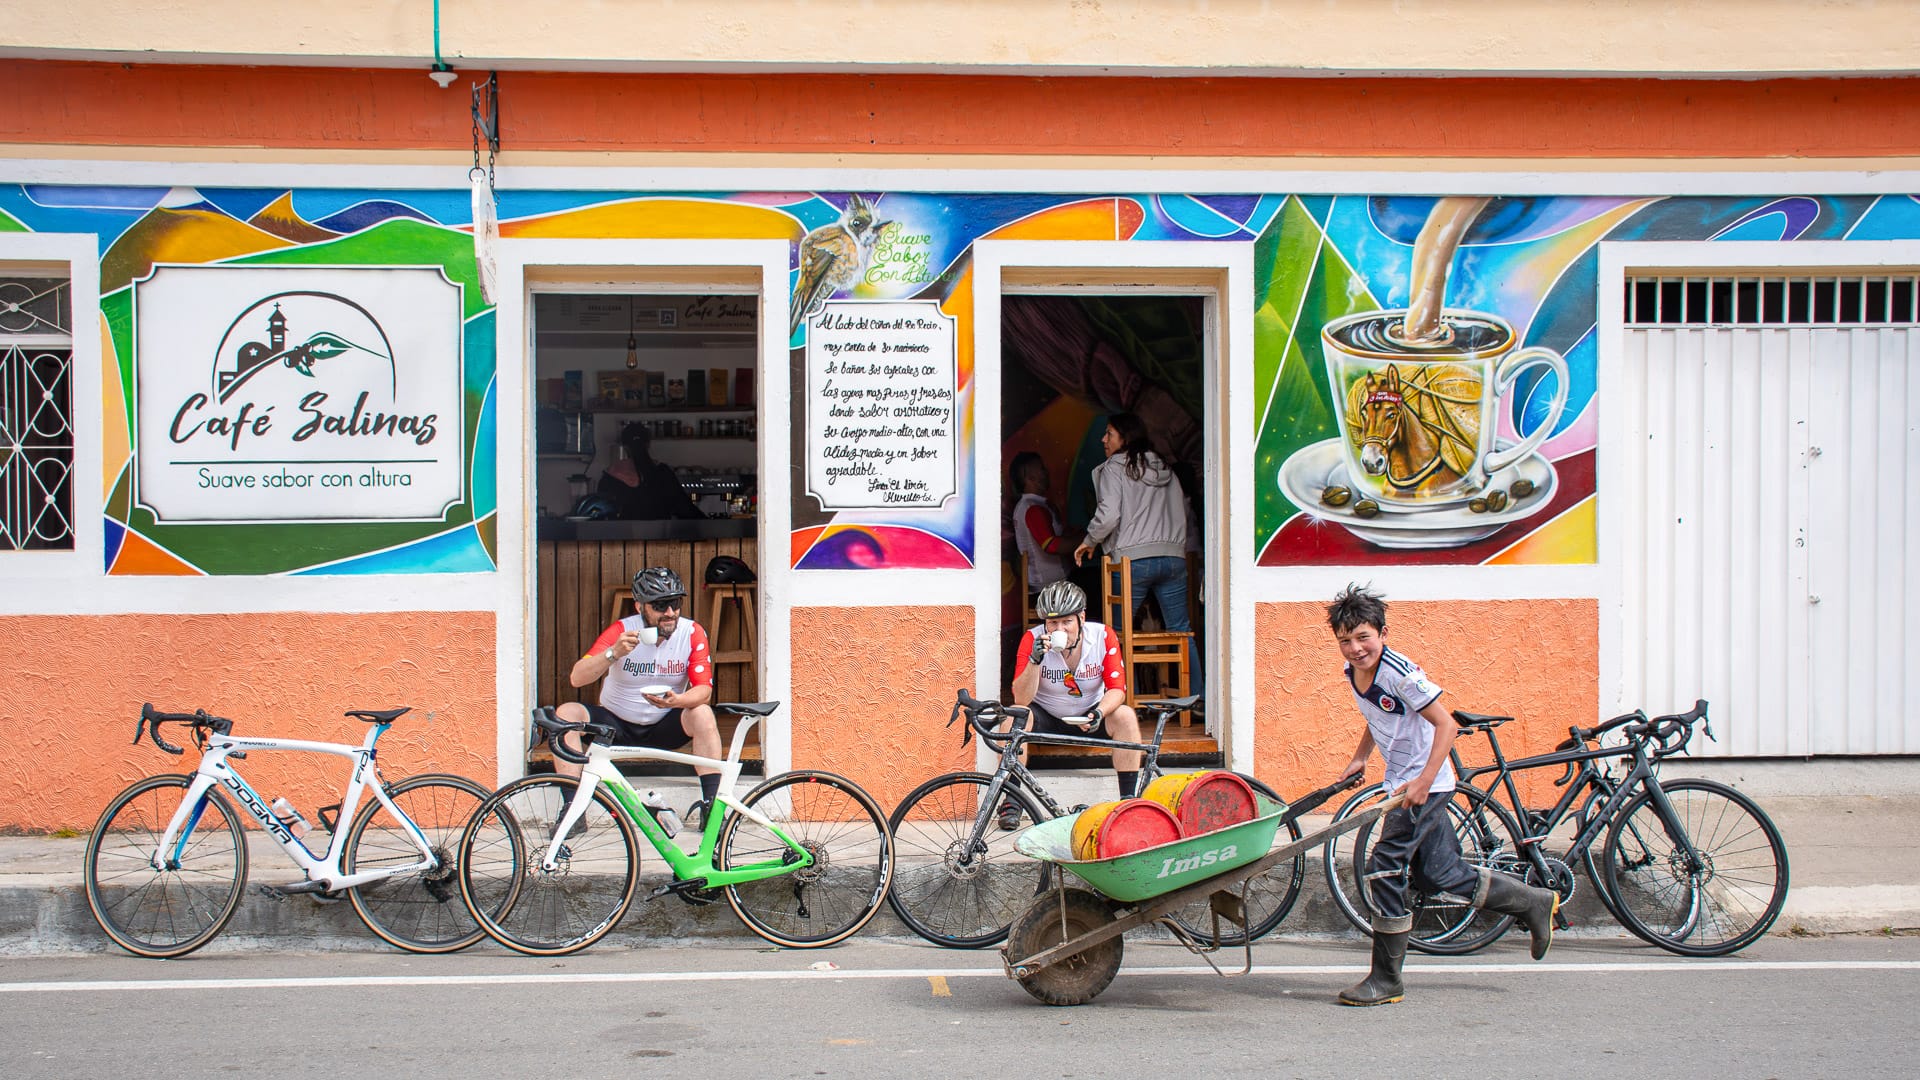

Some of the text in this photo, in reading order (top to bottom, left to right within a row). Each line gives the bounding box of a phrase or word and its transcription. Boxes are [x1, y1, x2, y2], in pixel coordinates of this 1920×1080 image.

[873, 244, 930, 265] Sabor
[816, 313, 834, 330] Al
[835, 314, 856, 330] lado
[856, 316, 868, 330] del
[893, 318, 903, 330] del
[824, 343, 842, 357] muy
[868, 341, 876, 352] de
[909, 388, 918, 406] y
[169, 391, 438, 451] Café Salinas
[942, 408, 950, 425] y
[885, 450, 896, 465] y
[199, 466, 412, 488] Suave sabor con altura
[622, 657, 656, 677] Beyond
[667, 659, 685, 674] Ride
[224, 775, 293, 845] DOGMA
[1156, 844, 1239, 879] Imsa
